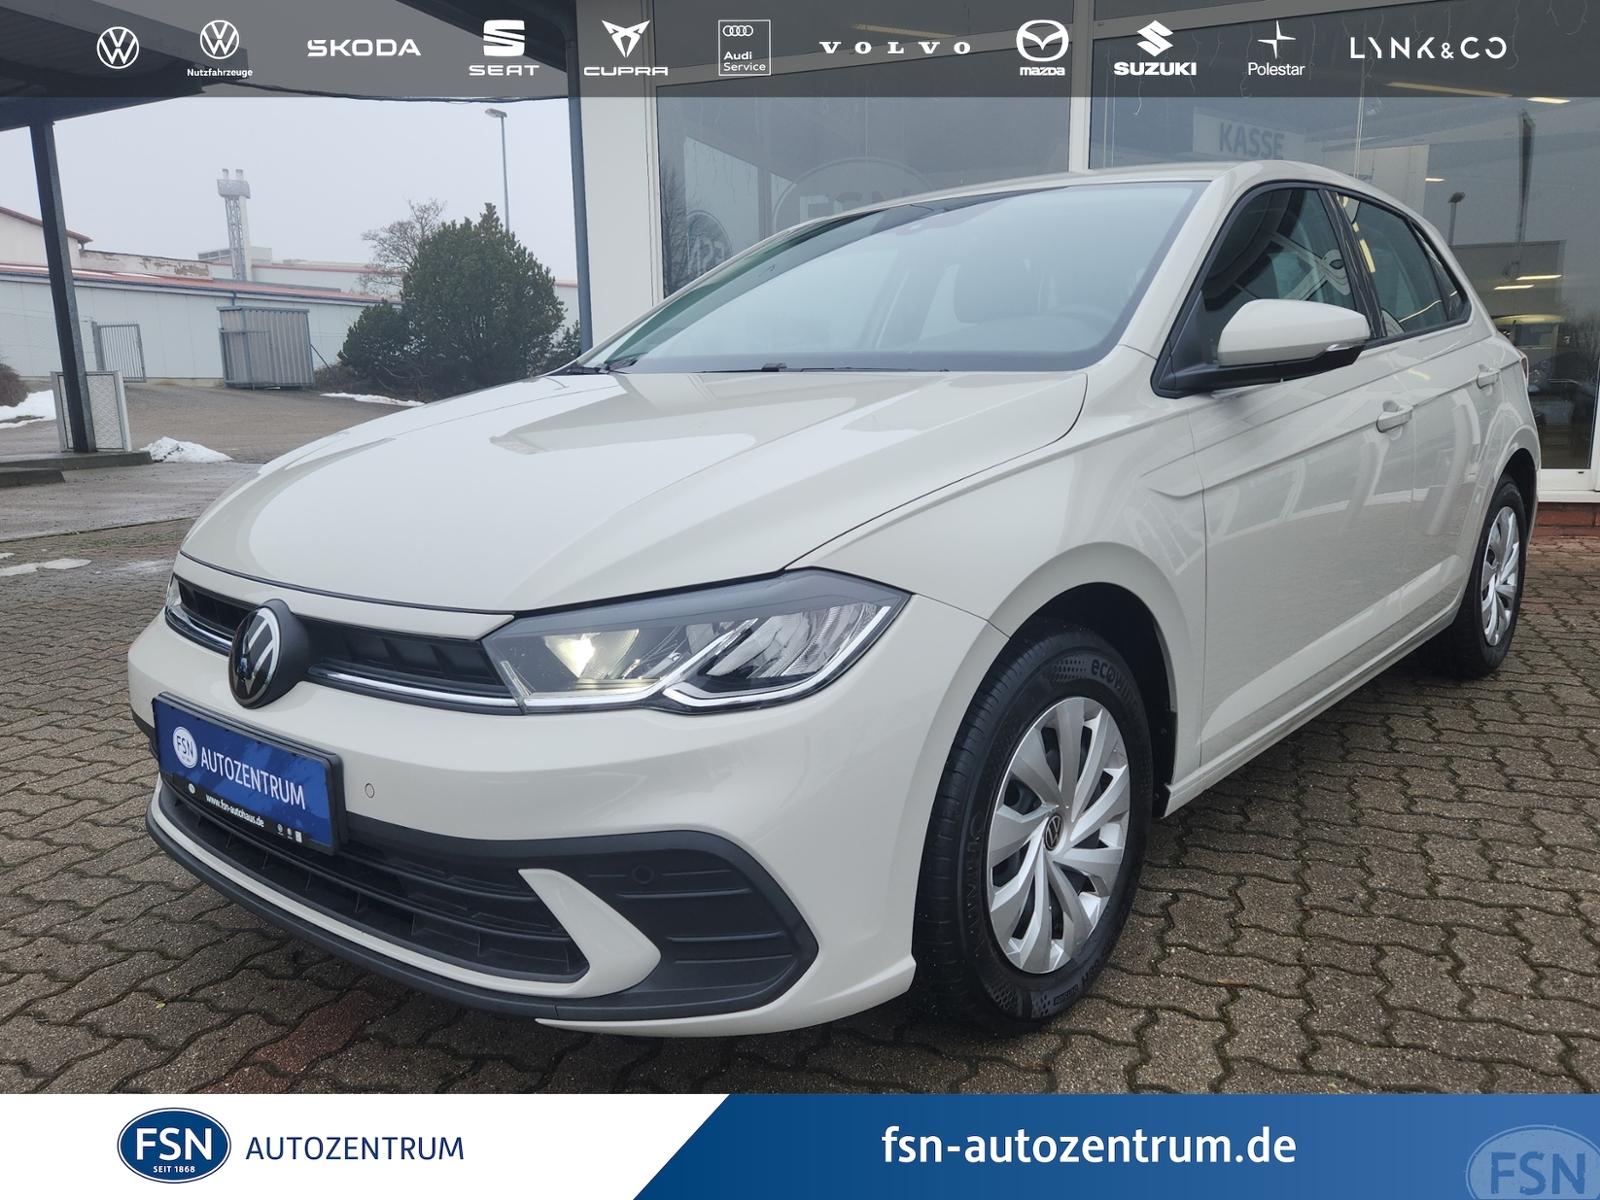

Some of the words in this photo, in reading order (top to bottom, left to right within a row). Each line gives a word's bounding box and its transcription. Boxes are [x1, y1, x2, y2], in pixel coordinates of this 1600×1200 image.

[1219, 122, 1285, 160] KASSE
[176, 735, 194, 758] FSN
[201, 746, 306, 811] AUTOZENTRUM
